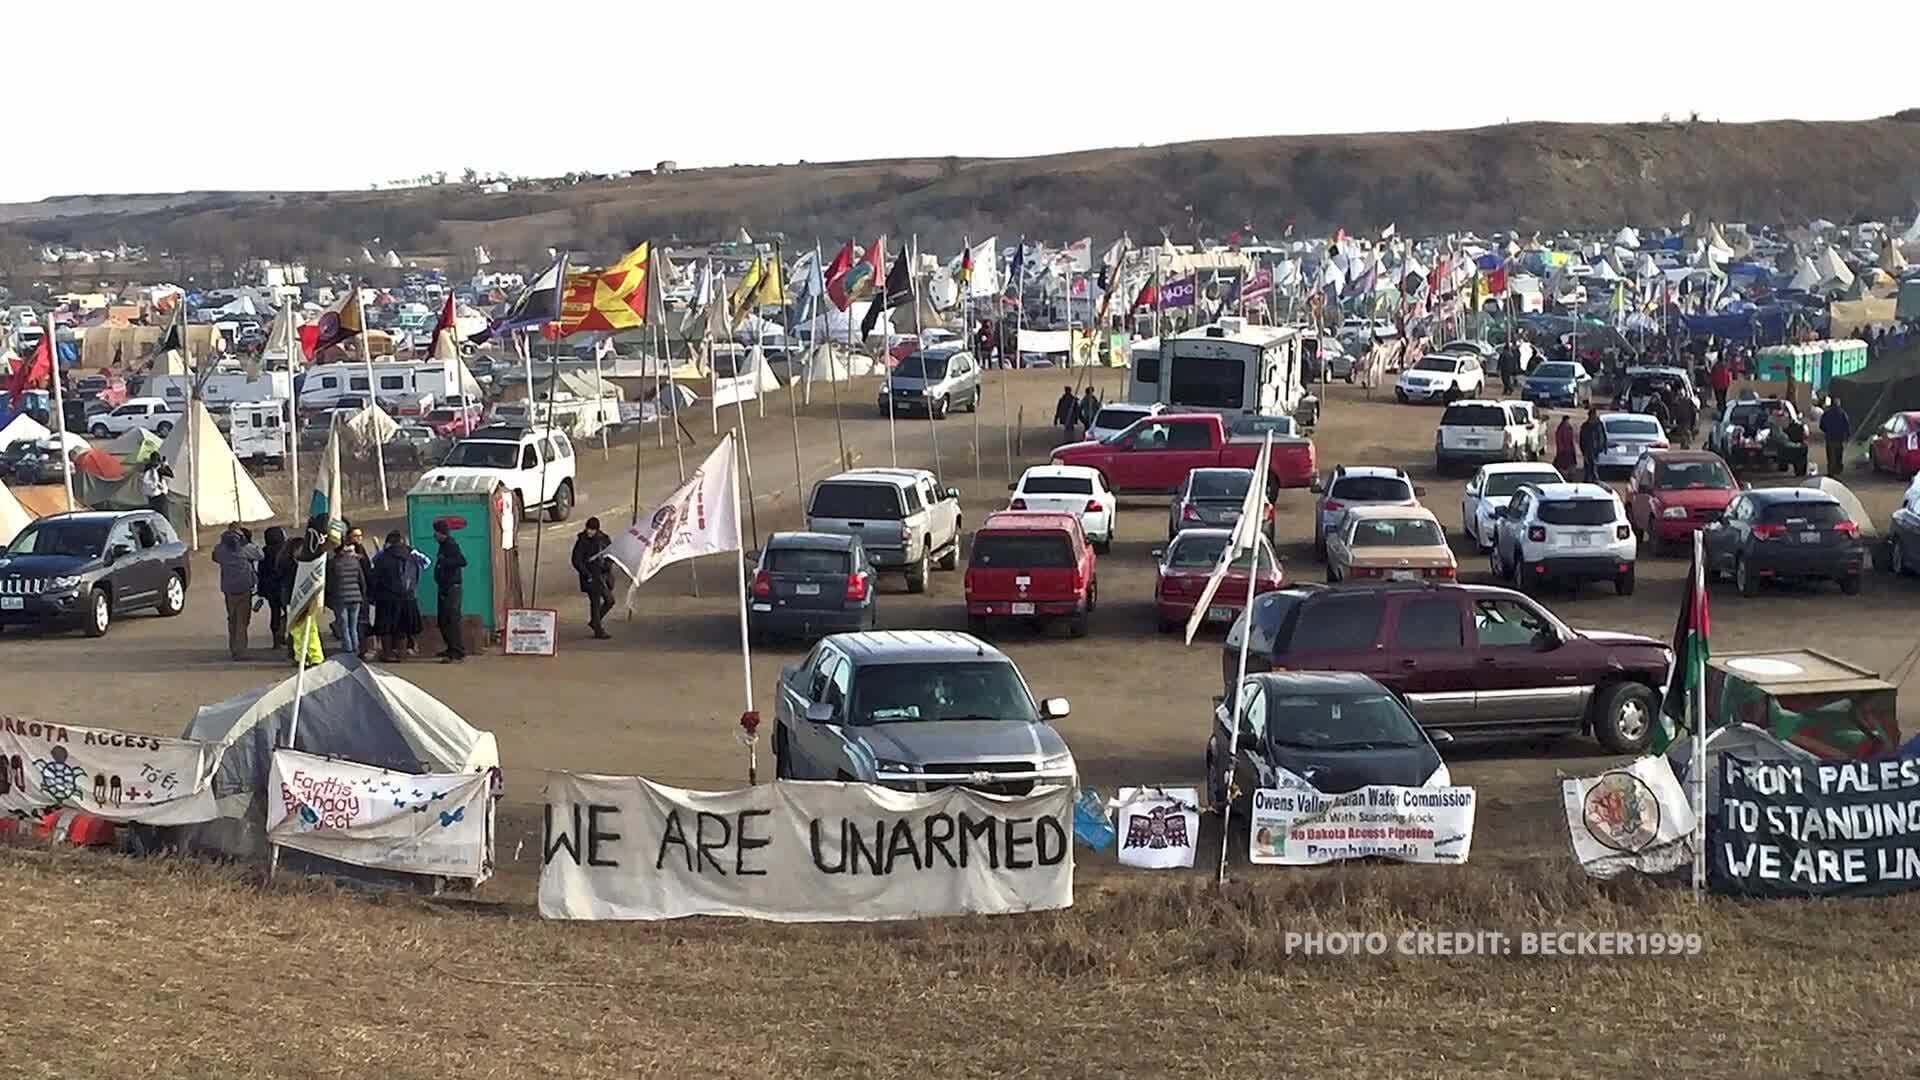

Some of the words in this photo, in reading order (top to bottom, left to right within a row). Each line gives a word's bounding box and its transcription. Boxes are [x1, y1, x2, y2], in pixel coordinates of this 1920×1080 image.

[0, 717, 69, 742] AKOTA
[84, 731, 161, 751] ACCESS
[1727, 757, 1804, 796] FROM
[1818, 758, 1920, 795] PALES
[285, 802, 354, 831] Prject
[1255, 791, 1294, 812] Owens
[1297, 793, 1333, 817] Valley
[1368, 788, 1400, 807] Water
[1403, 789, 1472, 807] Commission
[1329, 811, 1356, 823] With
[1359, 812, 1406, 825] Standing
[1724, 798, 1760, 833] TO
[544, 803, 621, 868] WE
[656, 809, 771, 875] ARE
[810, 812, 1067, 876] UNARMED
[1291, 828, 1305, 840] No
[1307, 828, 1346, 840] Dakota
[1348, 827, 1386, 839] Access
[1389, 826, 1434, 840] Pipeline
[1725, 842, 1781, 878] WE
[1790, 848, 1868, 884] ARE
